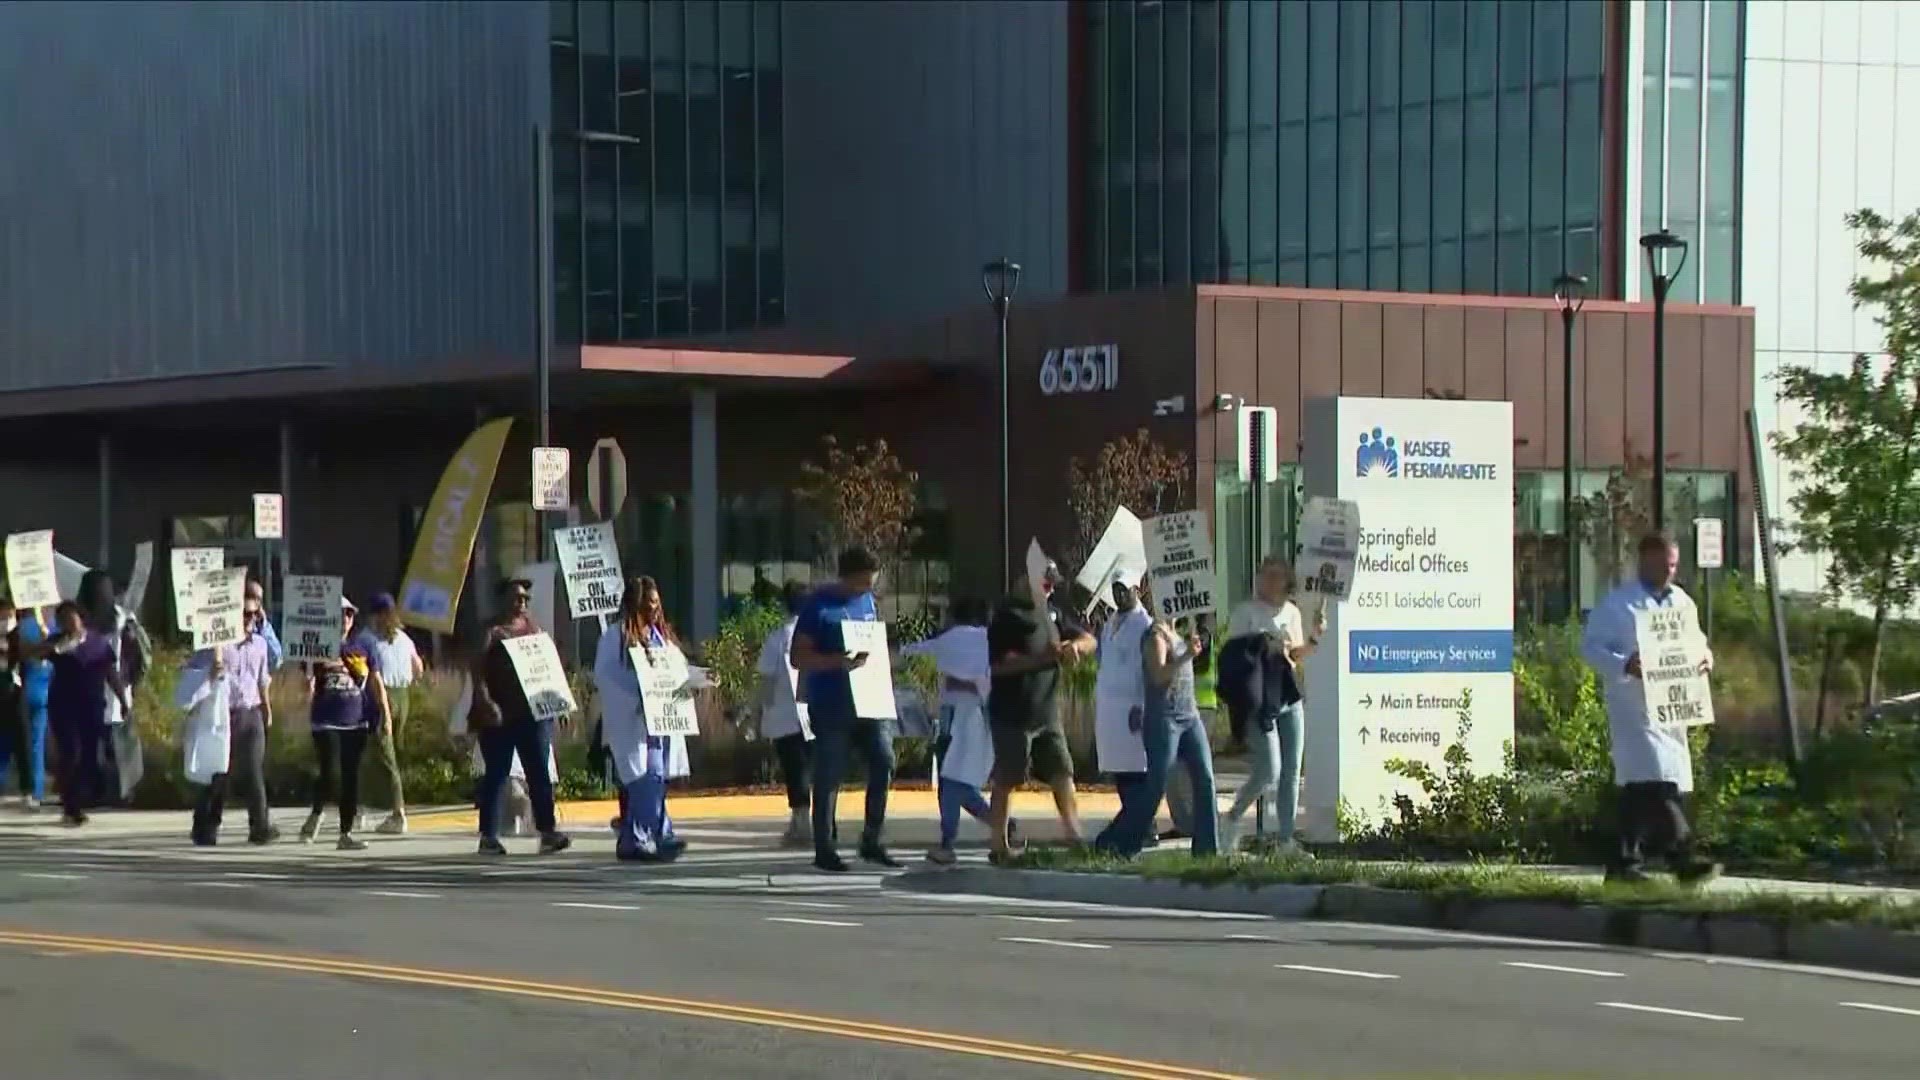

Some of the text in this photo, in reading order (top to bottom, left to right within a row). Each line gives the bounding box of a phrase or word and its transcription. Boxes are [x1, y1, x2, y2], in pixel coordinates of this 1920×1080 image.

[1039, 345, 1118, 394] 6551
[1403, 440, 1451, 458] KAISER
[1403, 462, 1497, 480] PERMANENTE
[1359, 526, 1436, 551] Springfield
[1357, 552, 1469, 573] Medical Offices
[587, 581, 605, 597] ON
[1174, 578, 1194, 595] ON
[577, 594, 620, 612] STRIKE
[1163, 591, 1211, 615] STRIKE
[1357, 590, 1481, 608] 6551 Loisdale Court
[1358, 644, 1497, 664] NO Emergency Services
[1380, 692, 1467, 710] Main Entranc
[1668, 684, 1687, 702] ON
[1657, 702, 1704, 723] STRIKE
[654, 716, 690, 731] STRIKE
[1380, 727, 1440, 747] Receiving
